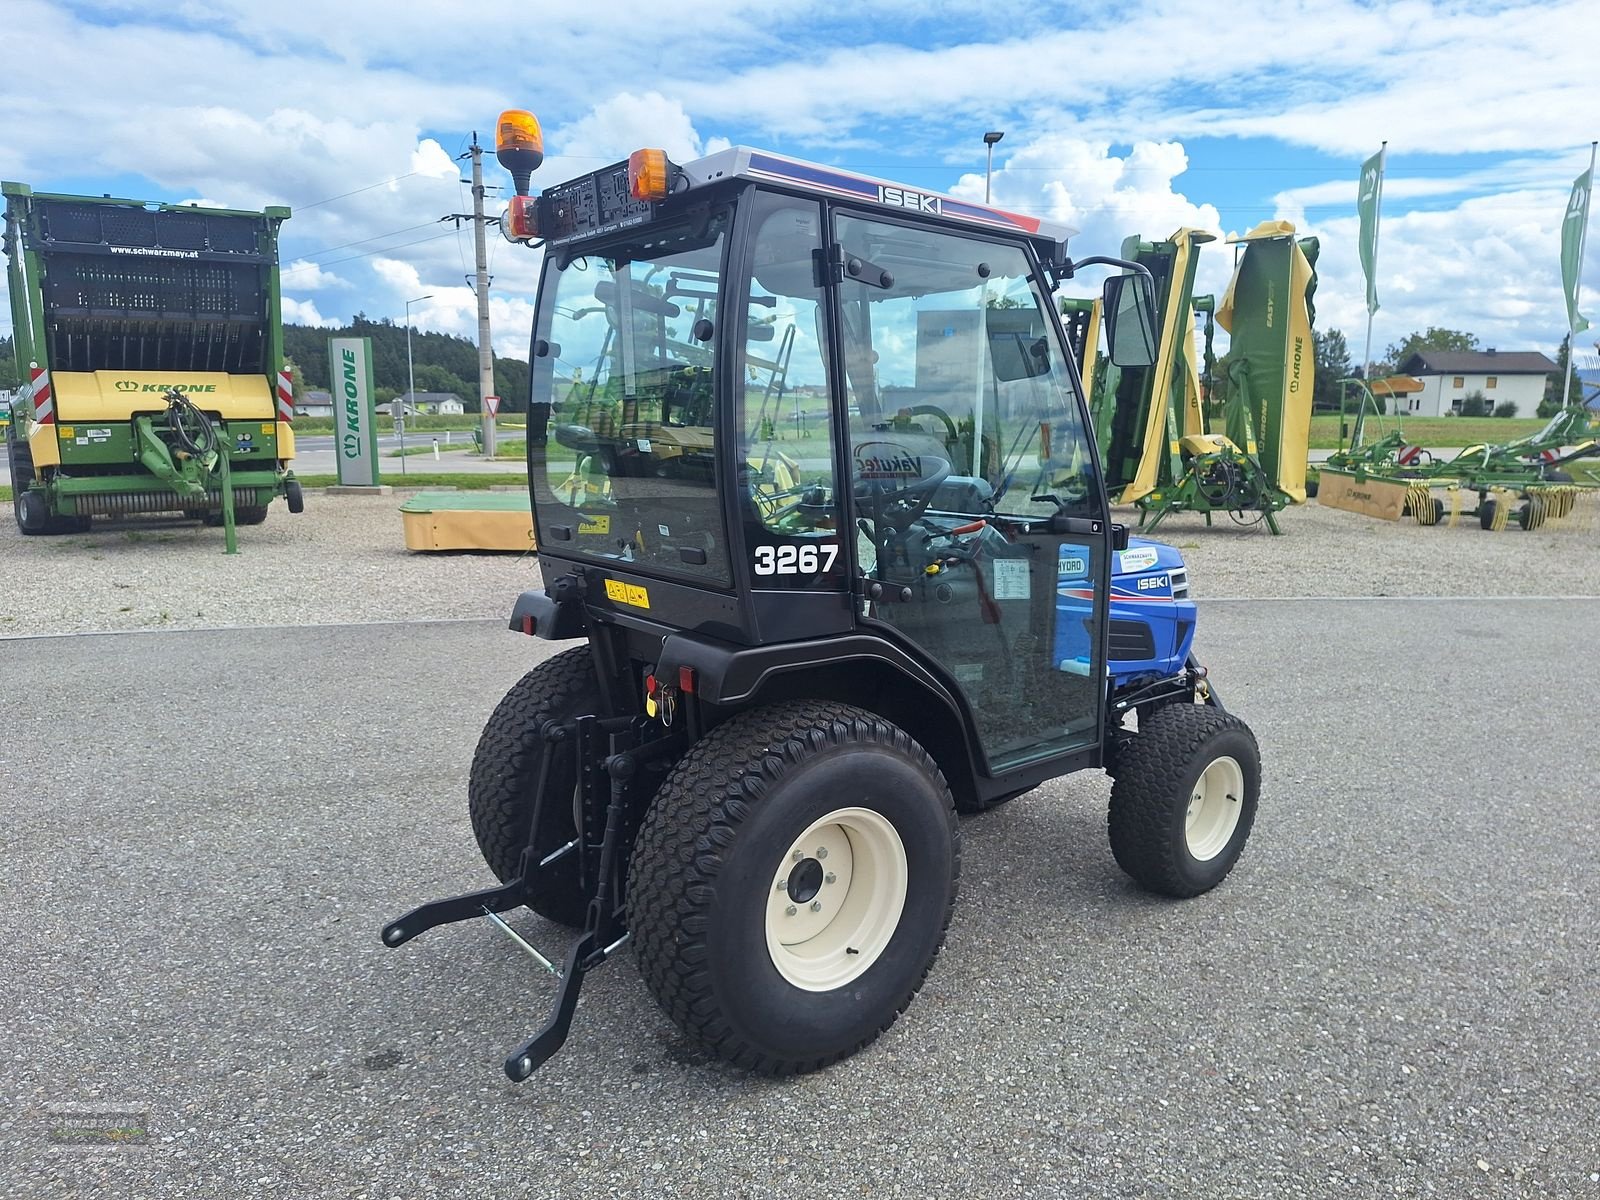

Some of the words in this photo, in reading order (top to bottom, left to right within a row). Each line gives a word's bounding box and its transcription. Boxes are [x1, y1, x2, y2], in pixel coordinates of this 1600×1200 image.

[878, 185, 942, 216] ISEKI
[110, 246, 199, 259] www.schwarzmayr.at
[1293, 336, 1303, 380] KRONE
[142, 384, 217, 393] KRONE
[342, 348, 359, 432] KRONE
[754, 544, 839, 576] 3267
[1137, 576, 1168, 590] ISEKI
